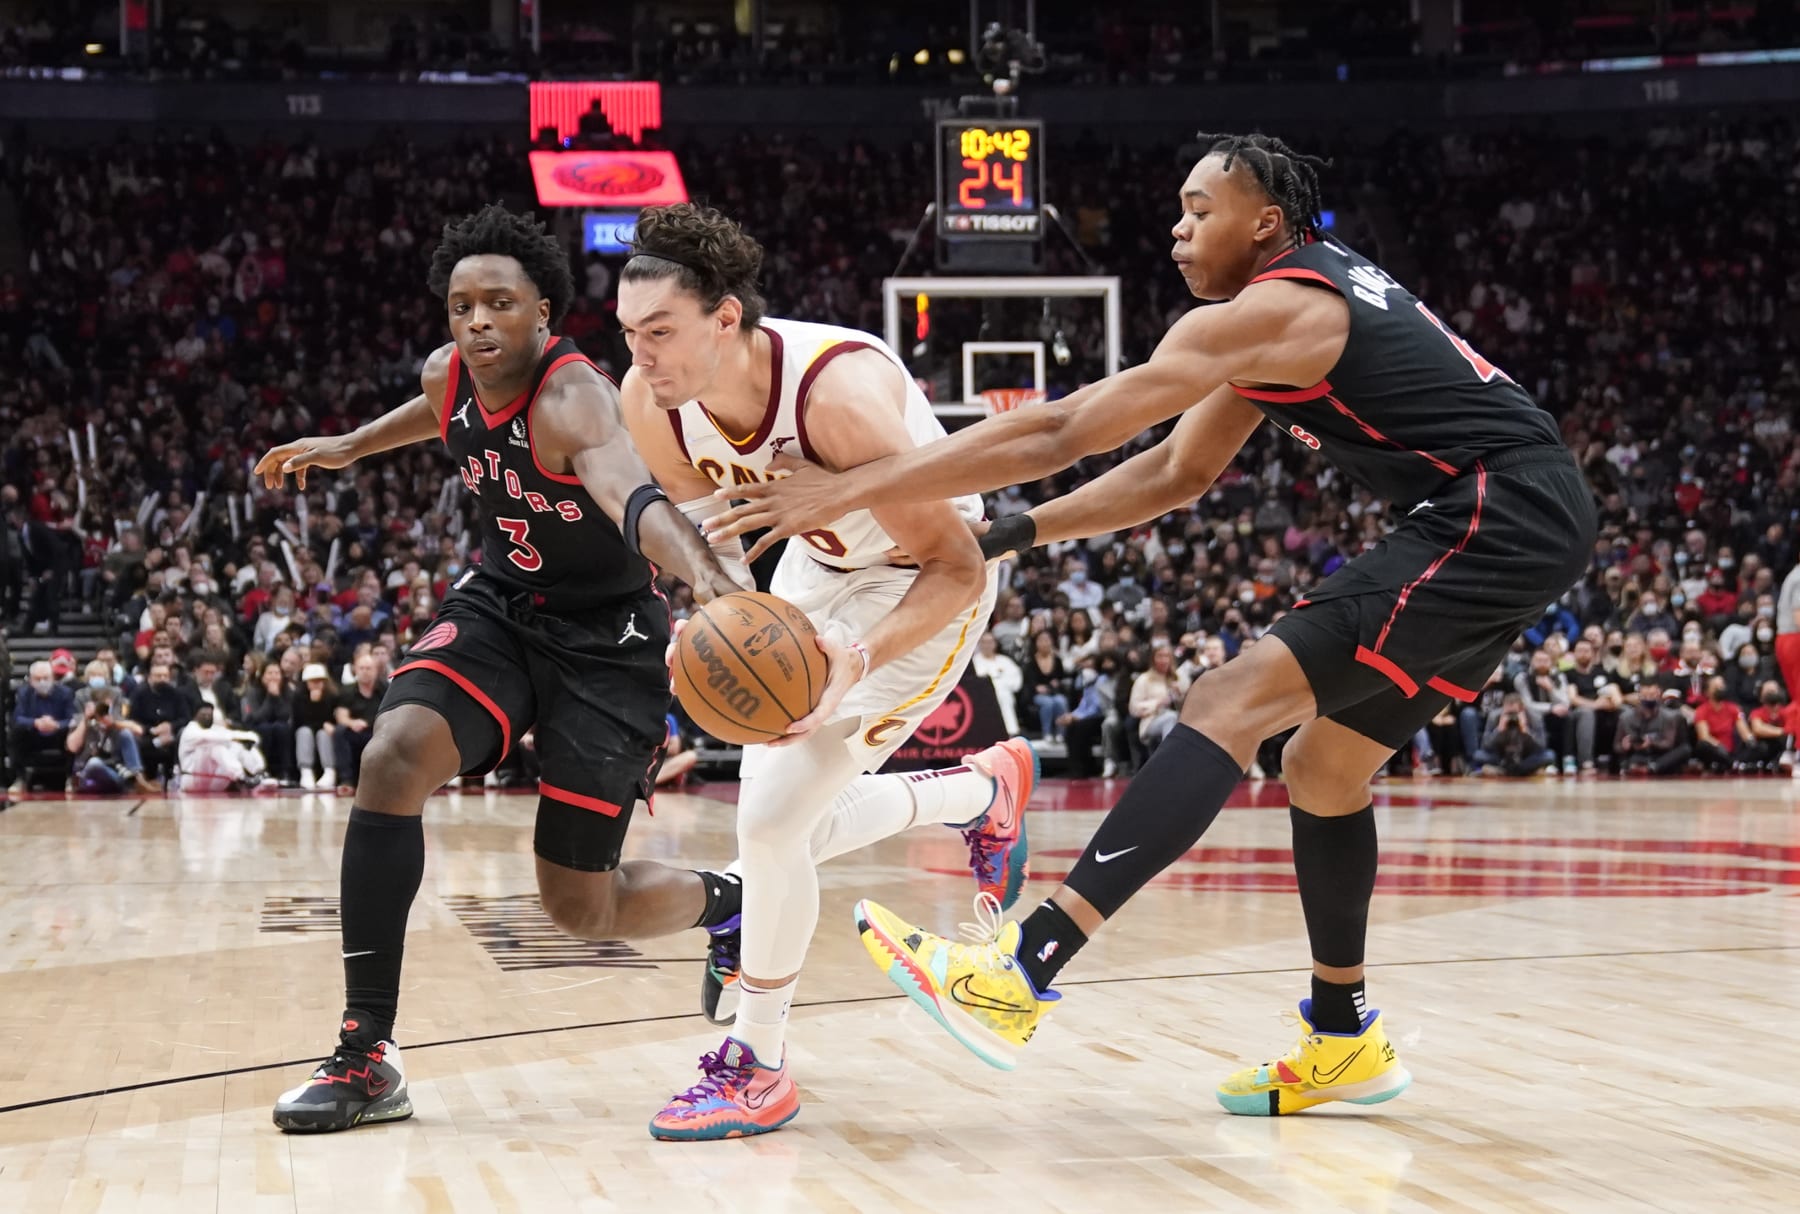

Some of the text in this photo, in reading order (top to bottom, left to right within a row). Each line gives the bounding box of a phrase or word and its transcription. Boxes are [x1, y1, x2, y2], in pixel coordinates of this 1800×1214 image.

[961, 129, 1030, 161] 10:42
[959, 158, 1023, 209] 24
[971, 215, 1039, 231] TISSOT
[460, 449, 583, 522] APTORS
[496, 516, 543, 572] 3
[691, 628, 761, 720] Wilson
